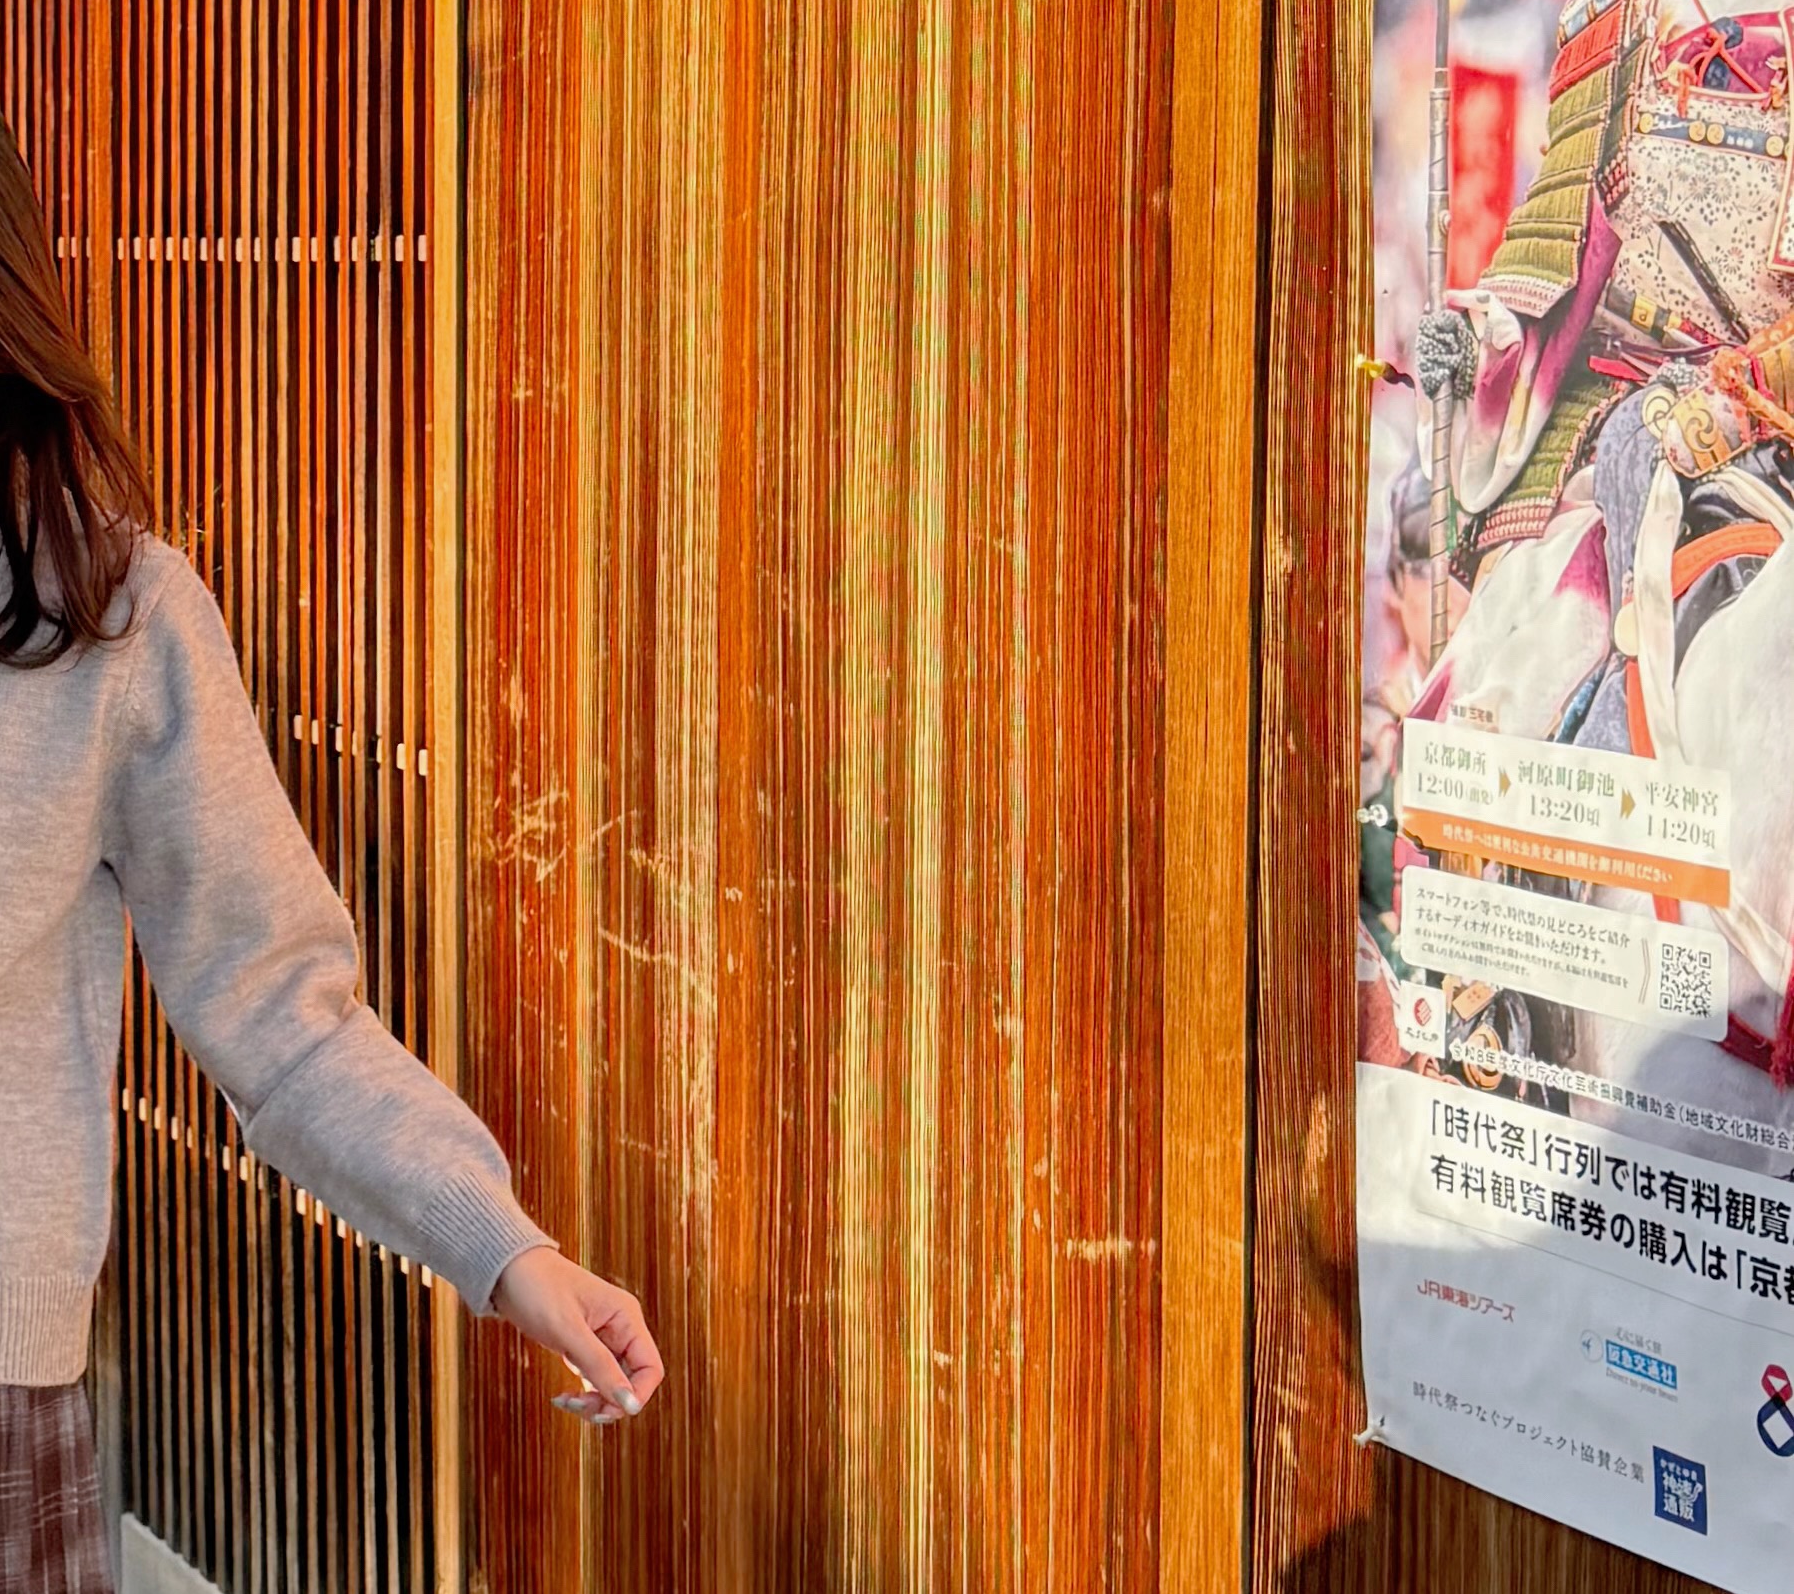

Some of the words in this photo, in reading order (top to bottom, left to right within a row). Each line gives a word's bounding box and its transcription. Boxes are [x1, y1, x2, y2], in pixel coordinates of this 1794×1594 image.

[1424, 741, 1486, 776] 京都御所
[1518, 760, 1615, 797] 河原町御池
[1645, 781, 1719, 817] 平安神宮
[1432, 1099, 1794, 1247] 「時代祭」行列では有料観覧
